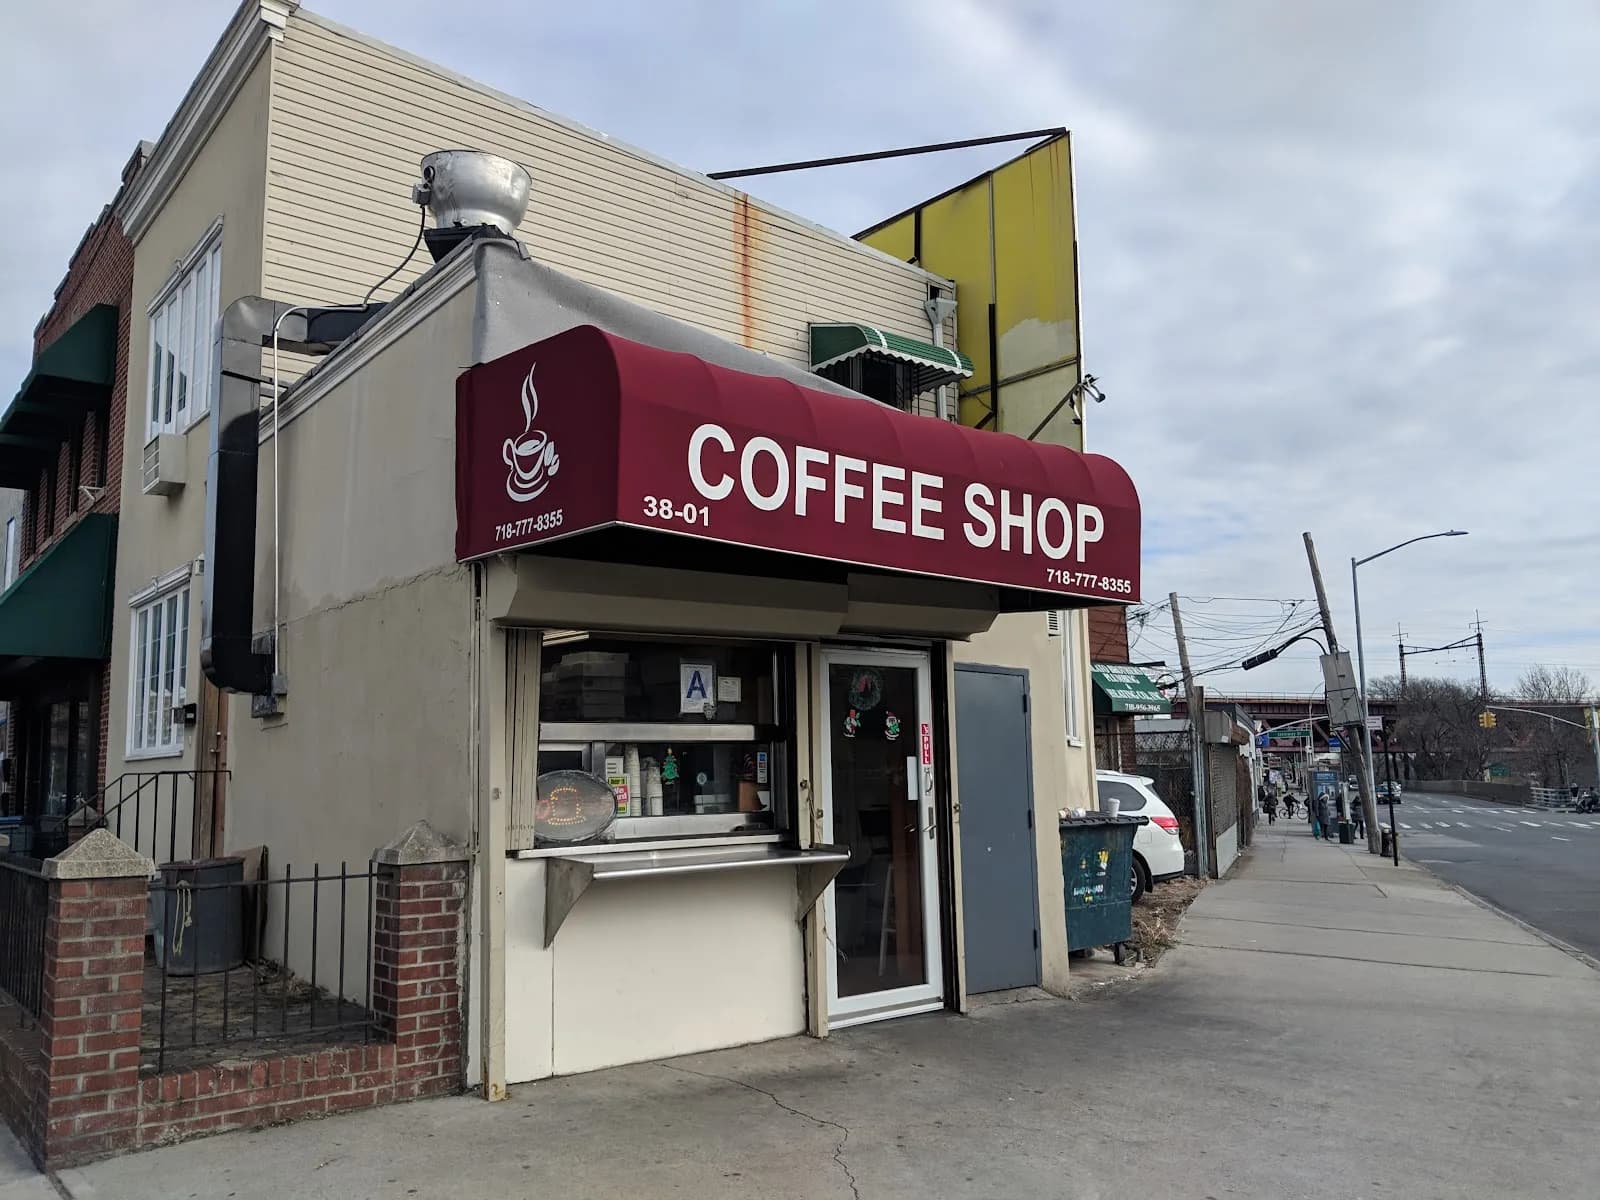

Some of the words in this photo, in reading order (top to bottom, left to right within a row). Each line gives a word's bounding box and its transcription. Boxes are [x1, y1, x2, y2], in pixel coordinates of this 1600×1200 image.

[687, 423, 945, 541] COFFEE
[963, 482, 1105, 563] SHOP
[495, 508, 563, 541] 718-777-8355
[643, 495, 709, 527] 38-01
[1046, 567, 1132, 594] 718-777-8355
[686, 670, 708, 699] A
